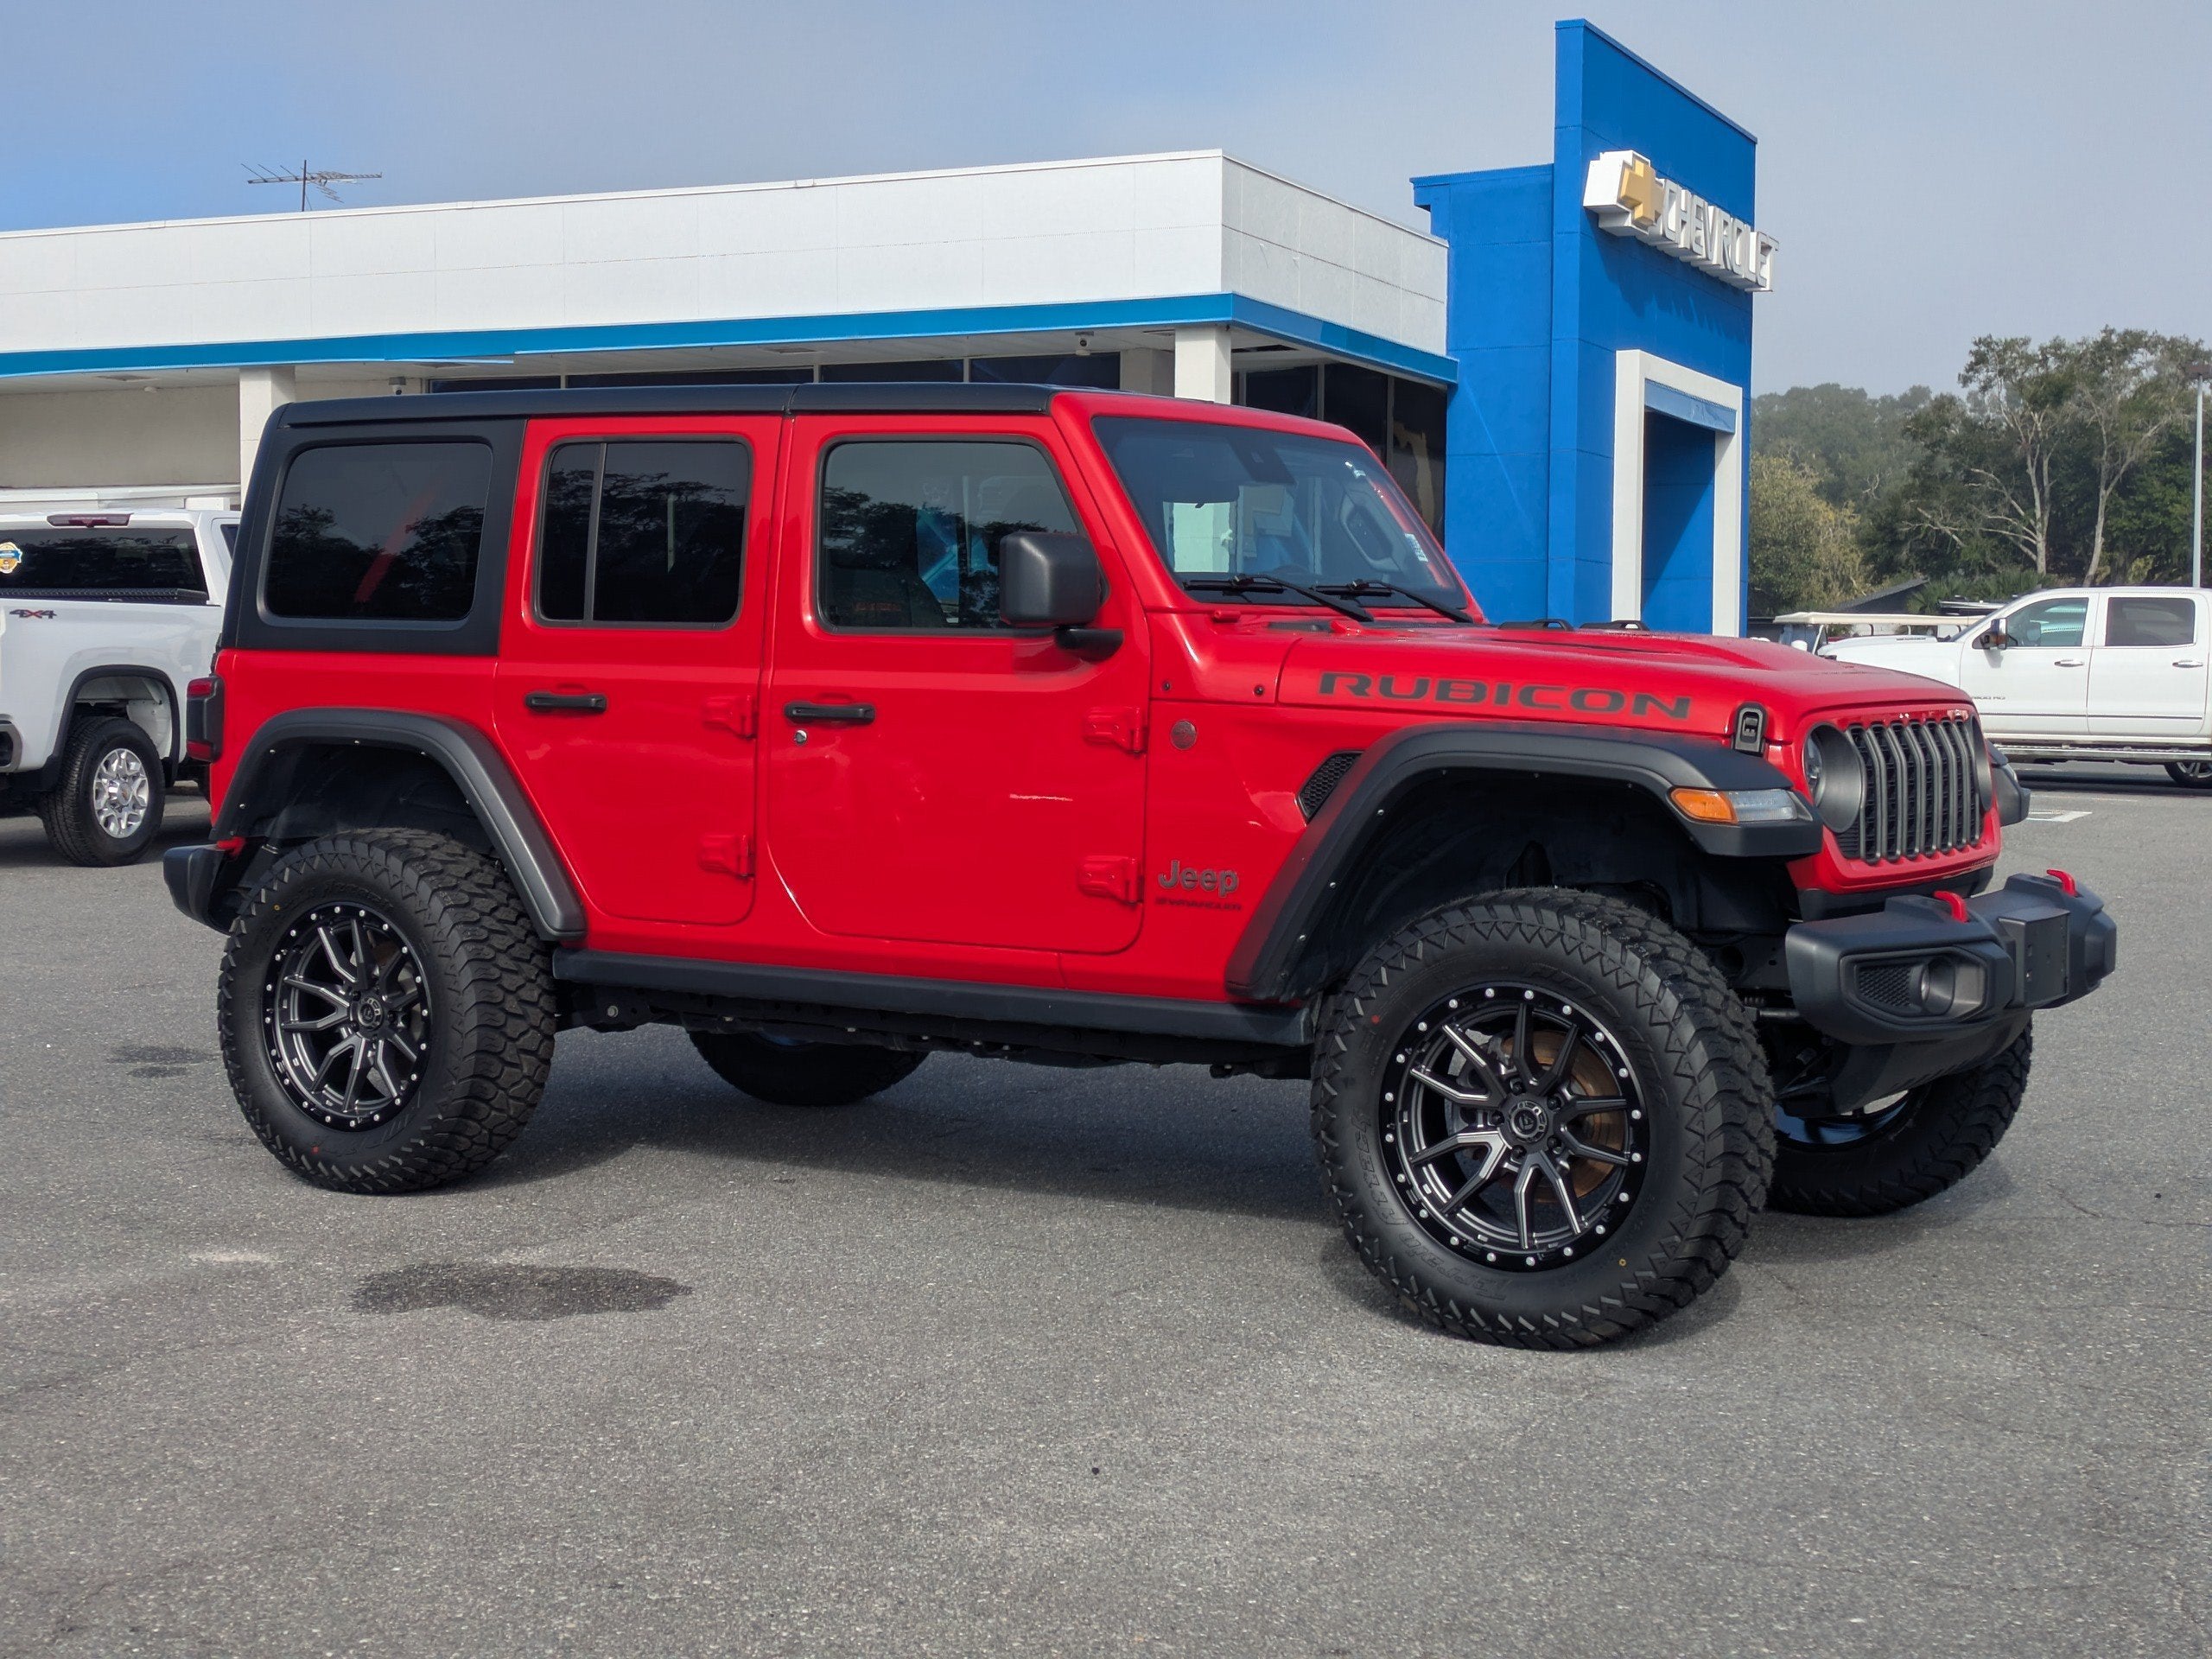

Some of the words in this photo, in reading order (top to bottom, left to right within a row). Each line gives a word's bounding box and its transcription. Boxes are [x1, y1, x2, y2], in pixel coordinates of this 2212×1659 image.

[1661, 177, 1780, 293] CHEVROLET
[1318, 671, 1691, 720] RUBICON
[1158, 860, 1239, 898] Jeep
